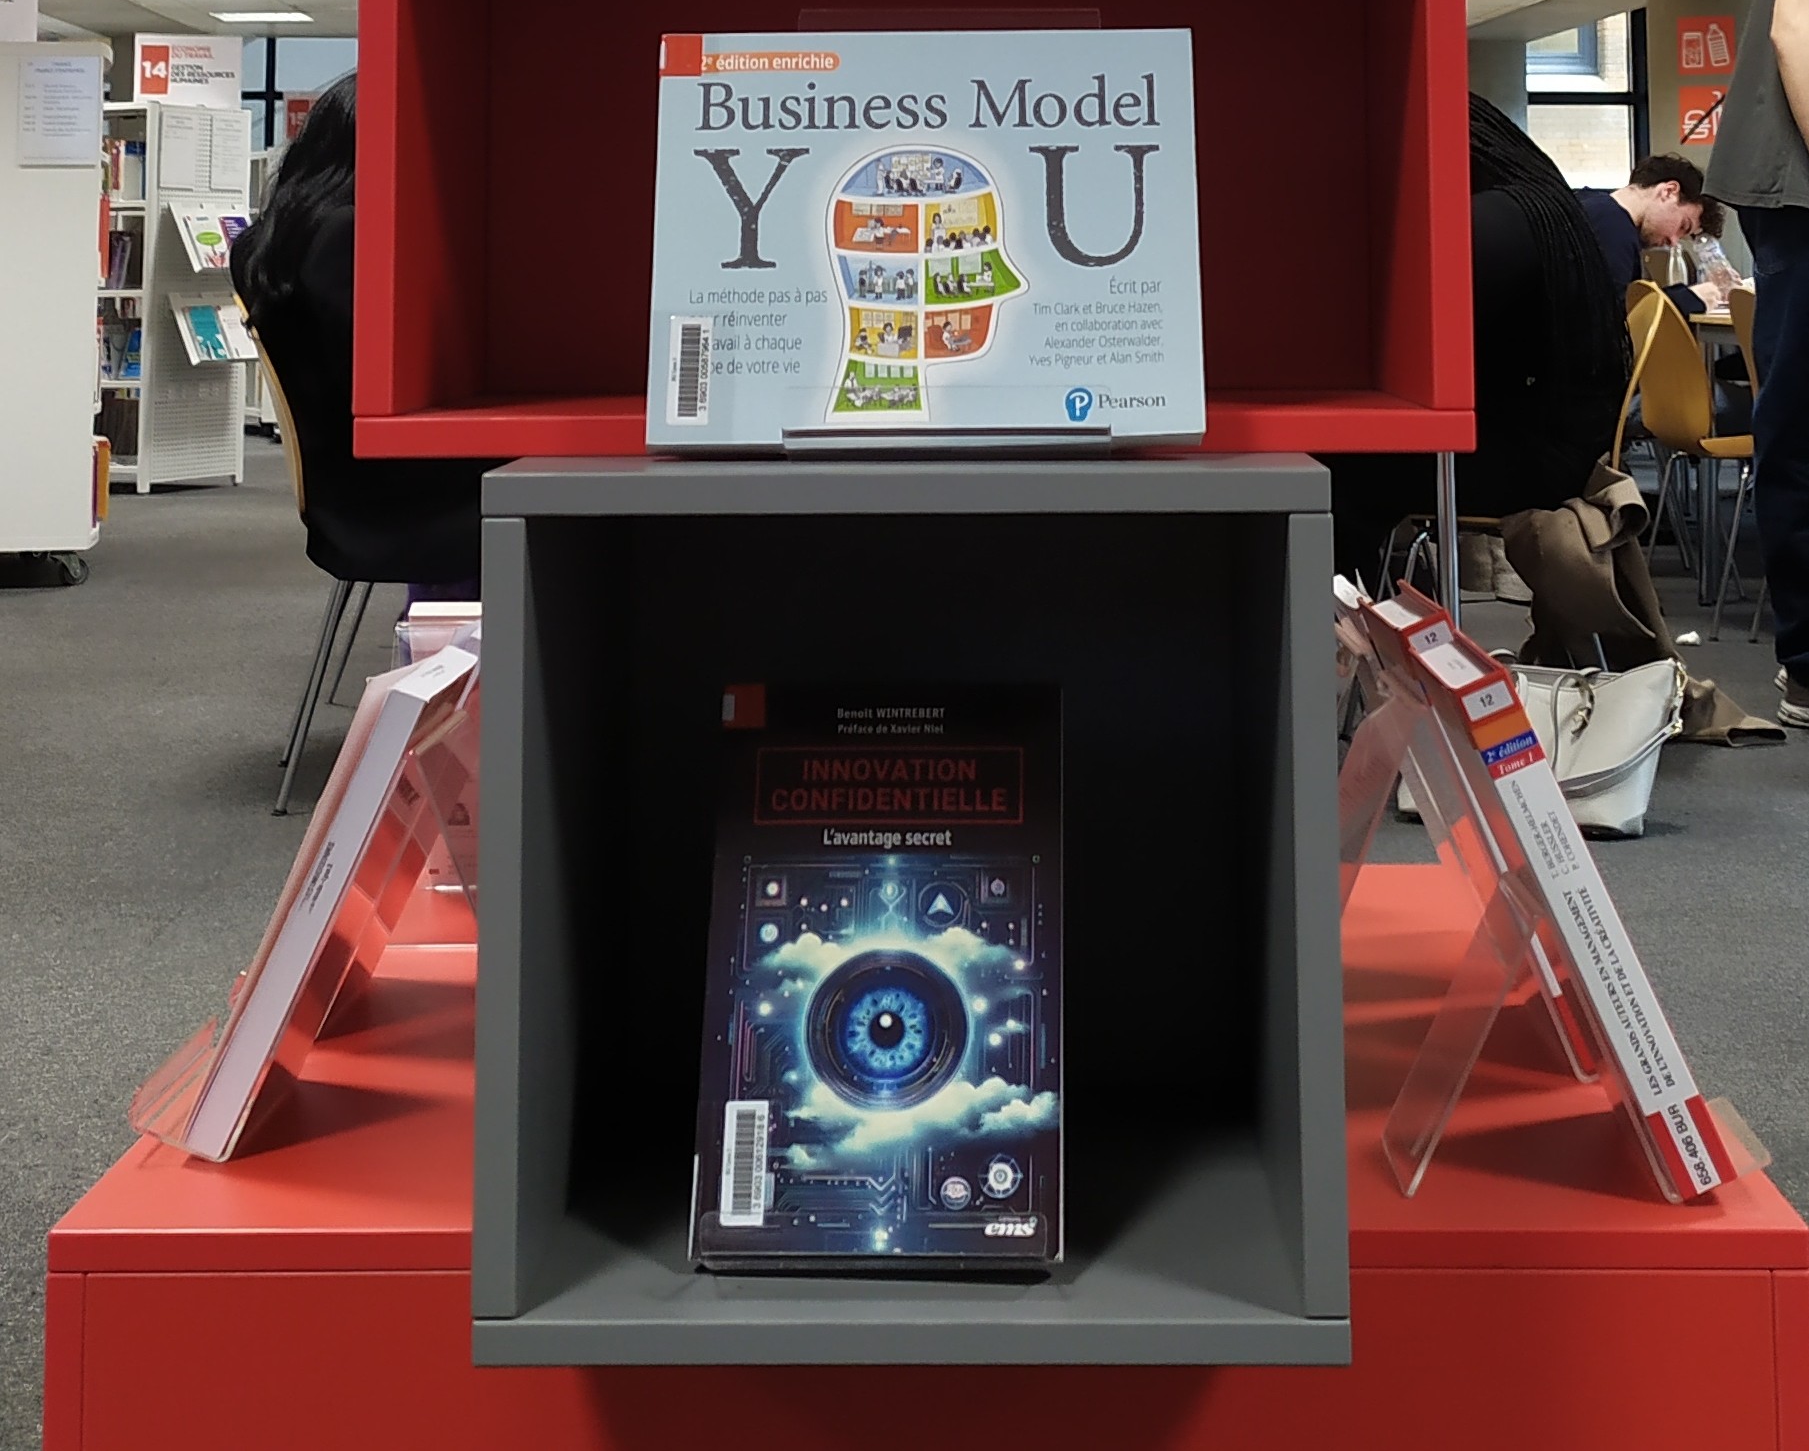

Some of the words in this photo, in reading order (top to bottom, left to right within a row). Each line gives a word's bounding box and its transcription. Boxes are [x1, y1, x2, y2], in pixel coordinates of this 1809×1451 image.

[142, 61, 168, 79] 14
[715, 53, 769, 70] édition
[772, 53, 834, 70] enrichie
[694, 80, 948, 132] Business
[968, 72, 1160, 130] Model
[1109, 275, 1138, 295] Écrit
[1141, 280, 1162, 296] par
[689, 290, 704, 304] La
[707, 288, 765, 304] méthode
[768, 290, 791, 306] pas
[794, 287, 802, 303] à
[805, 290, 828, 306] pas
[1033, 302, 1052, 315] Tim
[1054, 302, 1081, 315] Clark
[1082, 303, 1093, 315] et
[1095, 301, 1126, 314] Bruce
[1128, 301, 1163, 314] Hazen,
[722, 311, 788, 327] réinventer
[1055, 321, 1068, 332] en
[1070, 318, 1138, 332] collaboration
[1140, 319, 1163, 330] avec
[743, 334, 751, 350] à
[755, 335, 802, 354] chaque
[1044, 336, 1095, 349] Alexander
[1098, 334, 1164, 348] Osterwalder,
[726, 358, 743, 375] de
[745, 360, 780, 374] votre
[782, 358, 801, 373] vie
[1029, 354, 1052, 367] Yves
[1054, 353, 1093, 369] Pigneur
[1096, 353, 1107, 365] et
[1109, 351, 1132, 364] Alan
[1135, 350, 1165, 364] Smith
[1098, 393, 1166, 409] Pearson
[1424, 631, 1438, 645] 12
[1480, 693, 1494, 708] 12
[876, 707, 945, 719] WINTREBERT
[838, 724, 874, 734] Préface
[876, 724, 886, 734] de
[890, 724, 921, 734] Xavier
[924, 724, 944, 734] Niel
[1498, 734, 1533, 757] édition
[802, 758, 976, 783] INNOVATION
[1497, 757, 1526, 775] Tome
[771, 788, 1008, 813] CONFIDENTIELLE
[823, 827, 901, 850] L'avantage
[905, 829, 952, 846] secret
[1577, 886, 1613, 949] CRÉATIVITÉ
[1562, 890, 1602, 965] MANAGEMENT
[1608, 949, 1620, 964] LA
[1599, 966, 1610, 982] EN
[1613, 964, 1627, 981] DE
[1623, 981, 1636, 996] ET
[1605, 982, 1631, 1030] AUTEURS
[1629, 996, 1670, 1073] L'INNOVATION
[1628, 1031, 1654, 1075] GRANDS
[1648, 1076, 1662, 1096] LES
[1662, 1073, 1676, 1088] DE
[1667, 1104, 1688, 1134] BUR
[1682, 1135, 1712, 1186] 658.406
[984, 1222, 1036, 1237] ems
